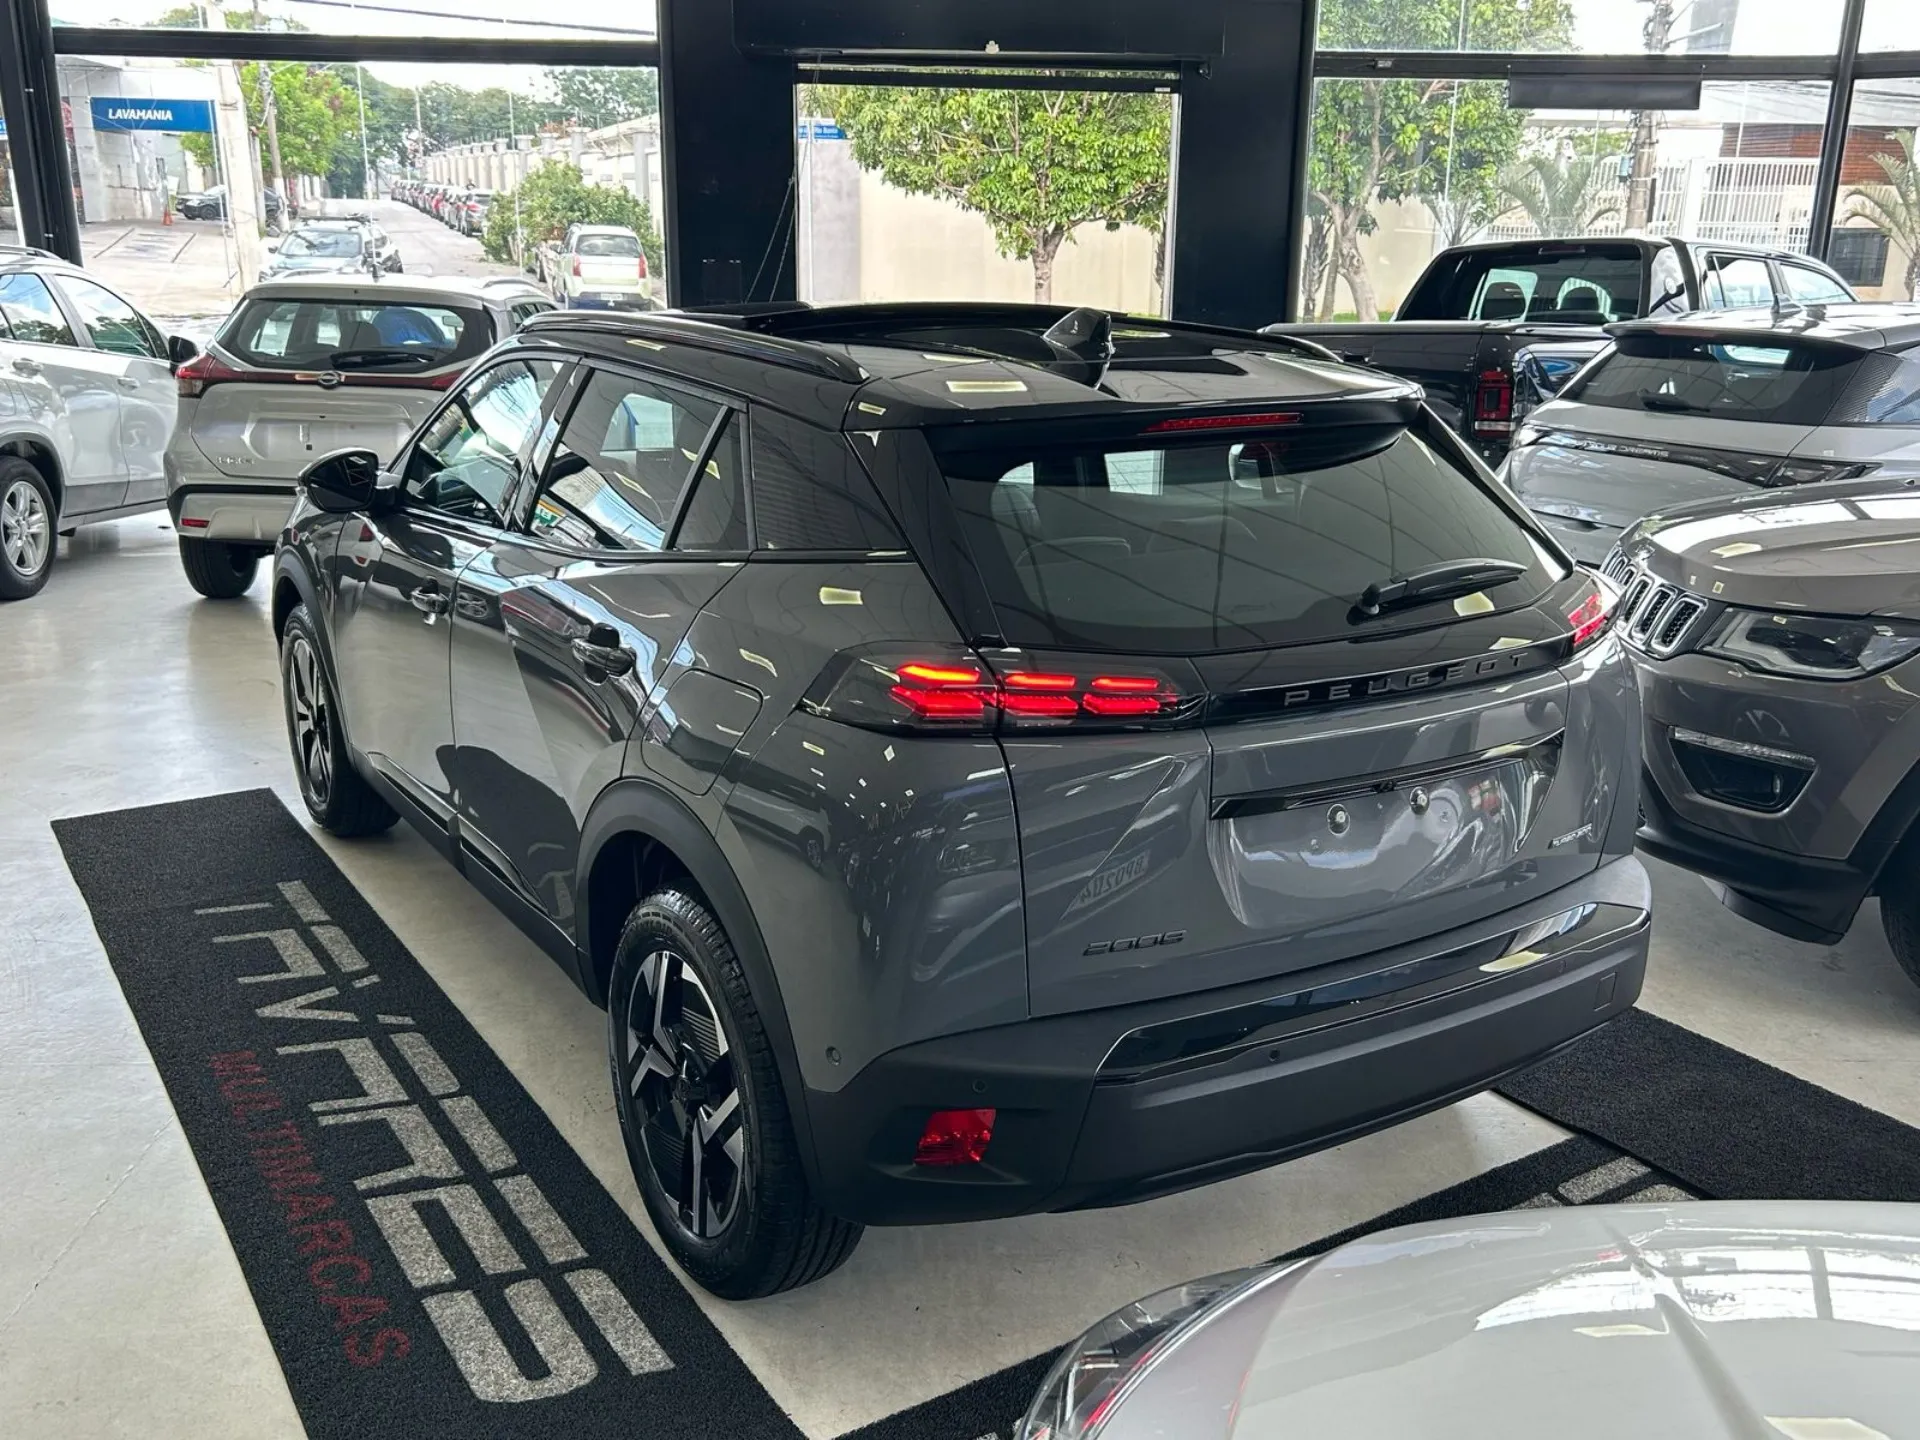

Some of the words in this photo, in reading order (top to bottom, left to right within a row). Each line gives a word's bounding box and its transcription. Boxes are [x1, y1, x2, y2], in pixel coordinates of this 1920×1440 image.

[108, 108, 174, 121] LAVAMANIA
[1284, 652, 1528, 707] PEUGEOT
[195, 880, 676, 1402] TAVARES
[209, 1049, 411, 1367] MULTIMARCAS
